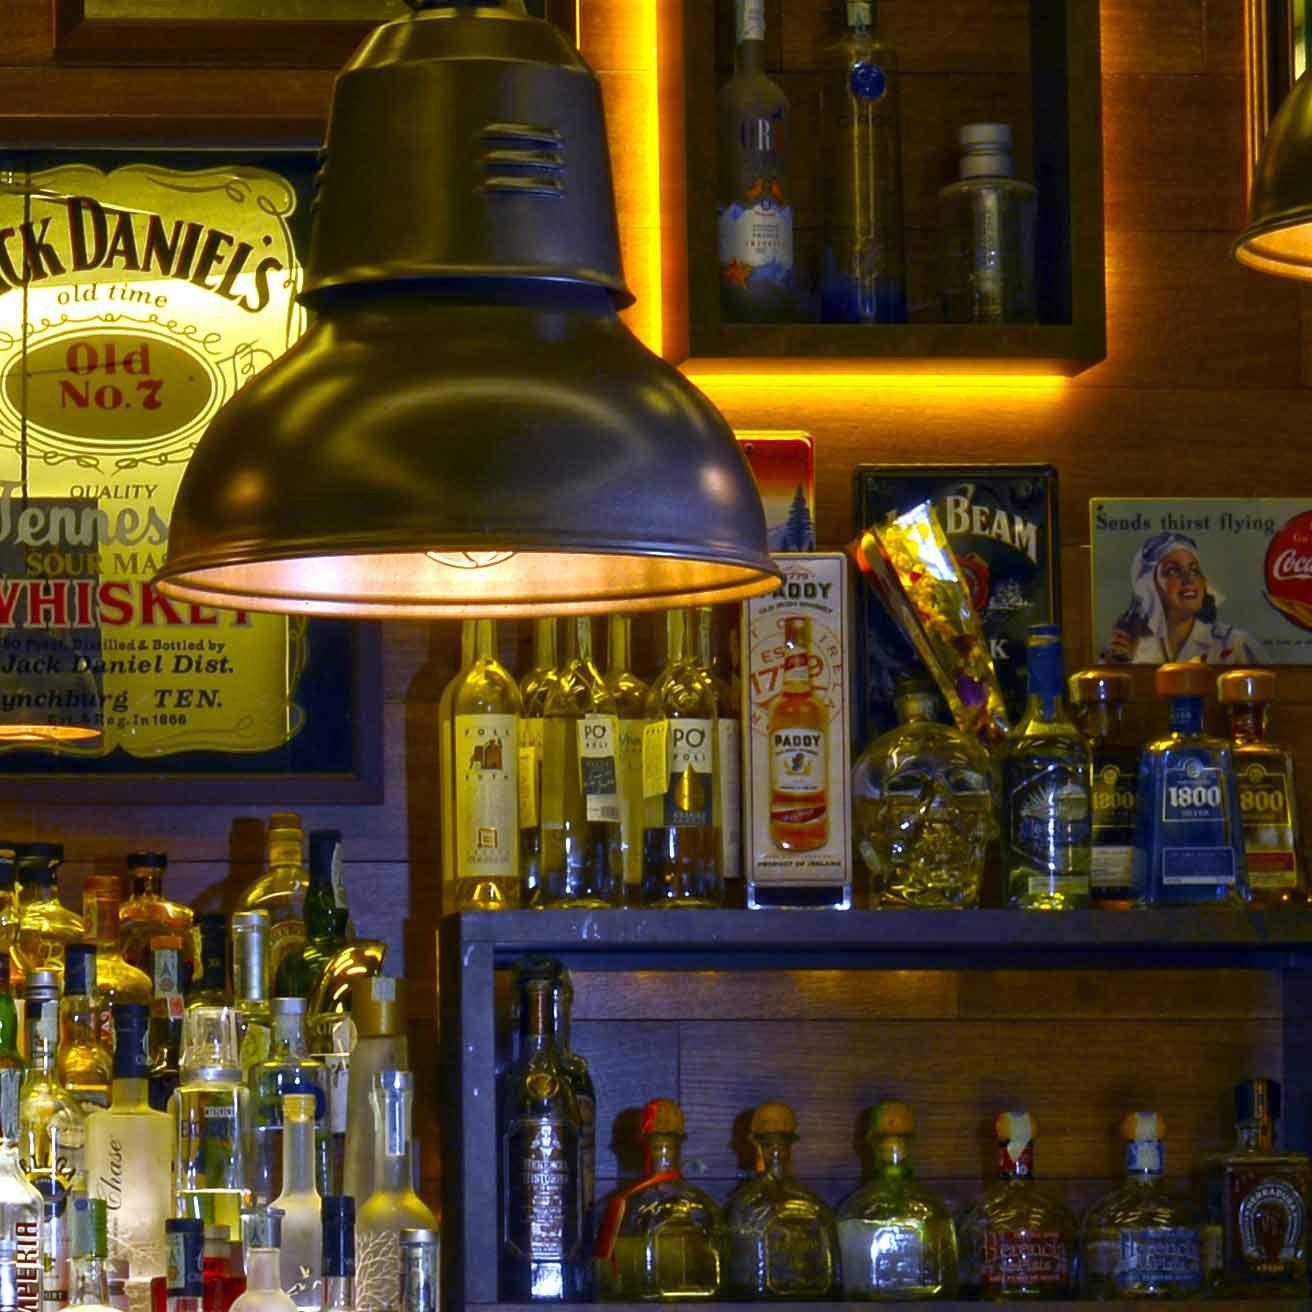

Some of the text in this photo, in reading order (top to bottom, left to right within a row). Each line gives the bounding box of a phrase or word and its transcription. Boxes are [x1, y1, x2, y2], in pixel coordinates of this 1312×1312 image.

[67, 196, 283, 313] DANIEL'S
[57, 283, 168, 308] old time
[66, 342, 150, 376] Old
[70, 484, 159, 500] QUALITY
[946, 494, 1039, 566] BEAM
[1096, 512, 1276, 534] Sends thirst flying
[27, 552, 105, 577] SOUR
[762, 583, 833, 600] ADDY
[153, 640, 206, 651] Bottled
[208, 640, 225, 653] by
[1, 654, 235, 674] Jack Daniel Dist.
[153, 689, 224, 708] TEN.
[773, 733, 823, 748] PADDY
[1169, 786, 1222, 808] 1800
[1239, 790, 1284, 811] 800
[101, 1138, 123, 1212] Chase
